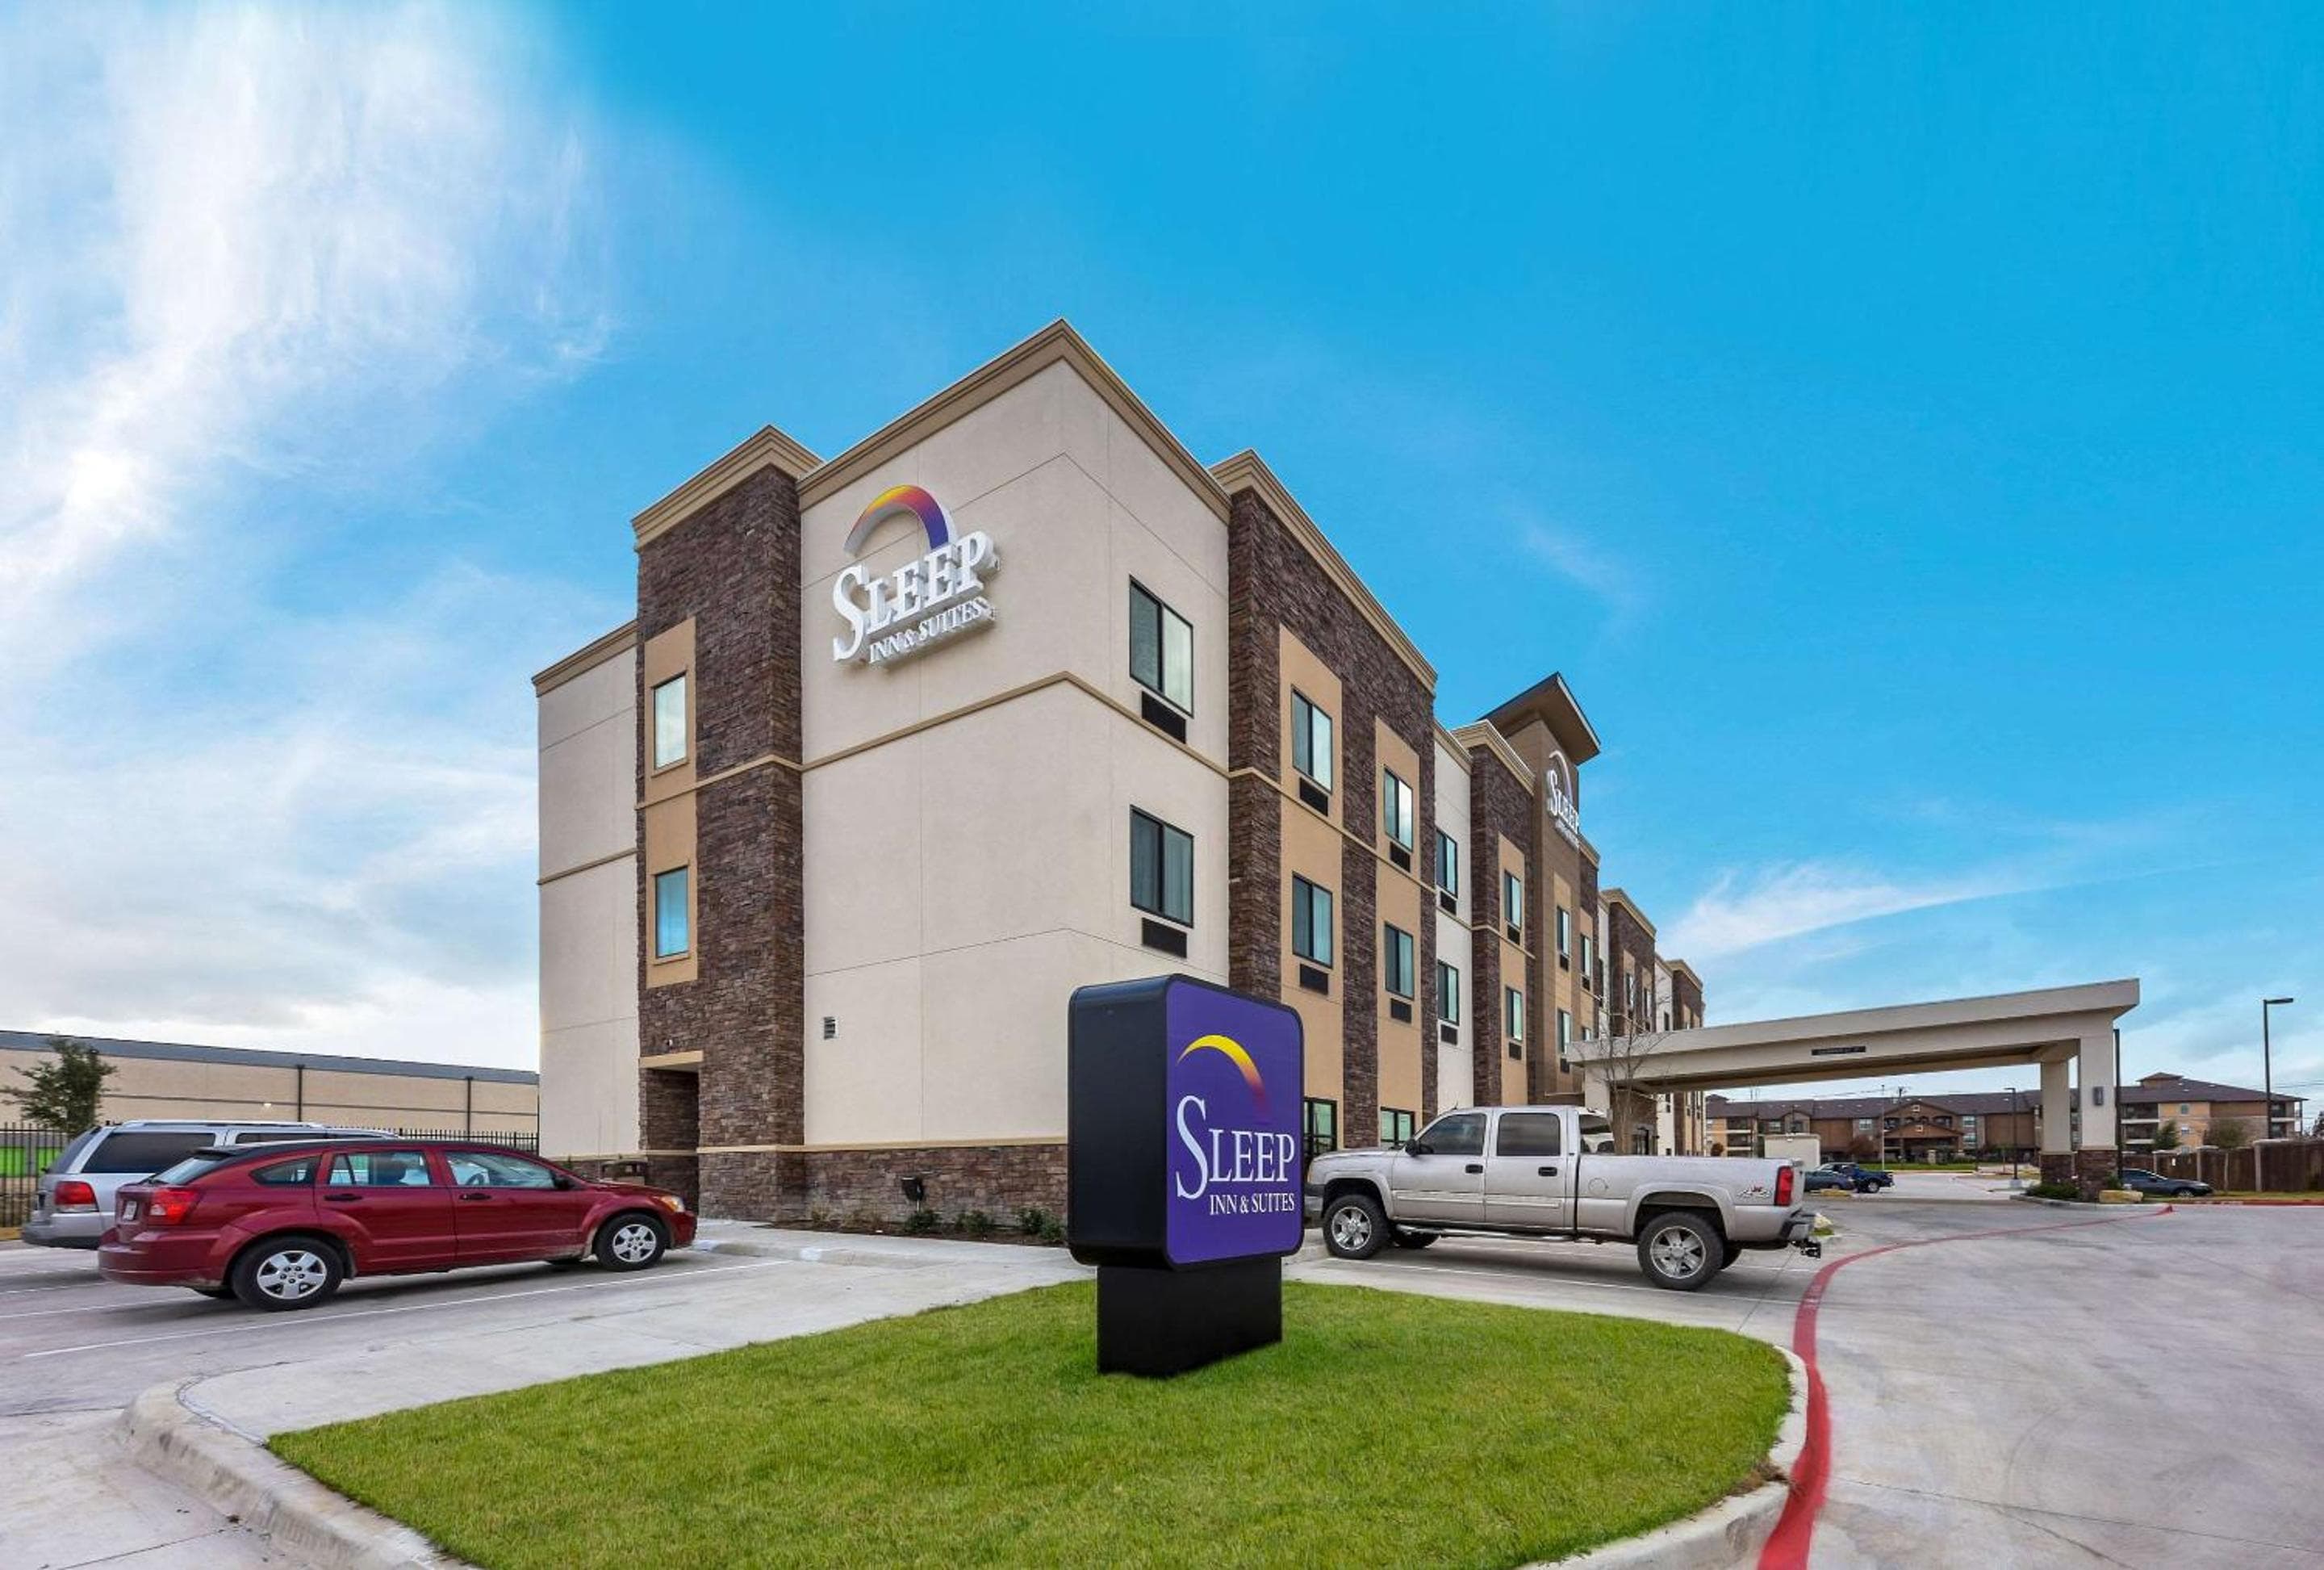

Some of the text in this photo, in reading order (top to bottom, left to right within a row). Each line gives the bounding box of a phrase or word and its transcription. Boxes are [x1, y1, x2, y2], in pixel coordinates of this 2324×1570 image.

[833, 530, 995, 661] SLEEP
[869, 630, 903, 664] INN
[918, 597, 989, 641] SUITES
[1176, 1095, 1294, 1199] SLEEP
[1210, 1193, 1294, 1216] INN & SUITES
